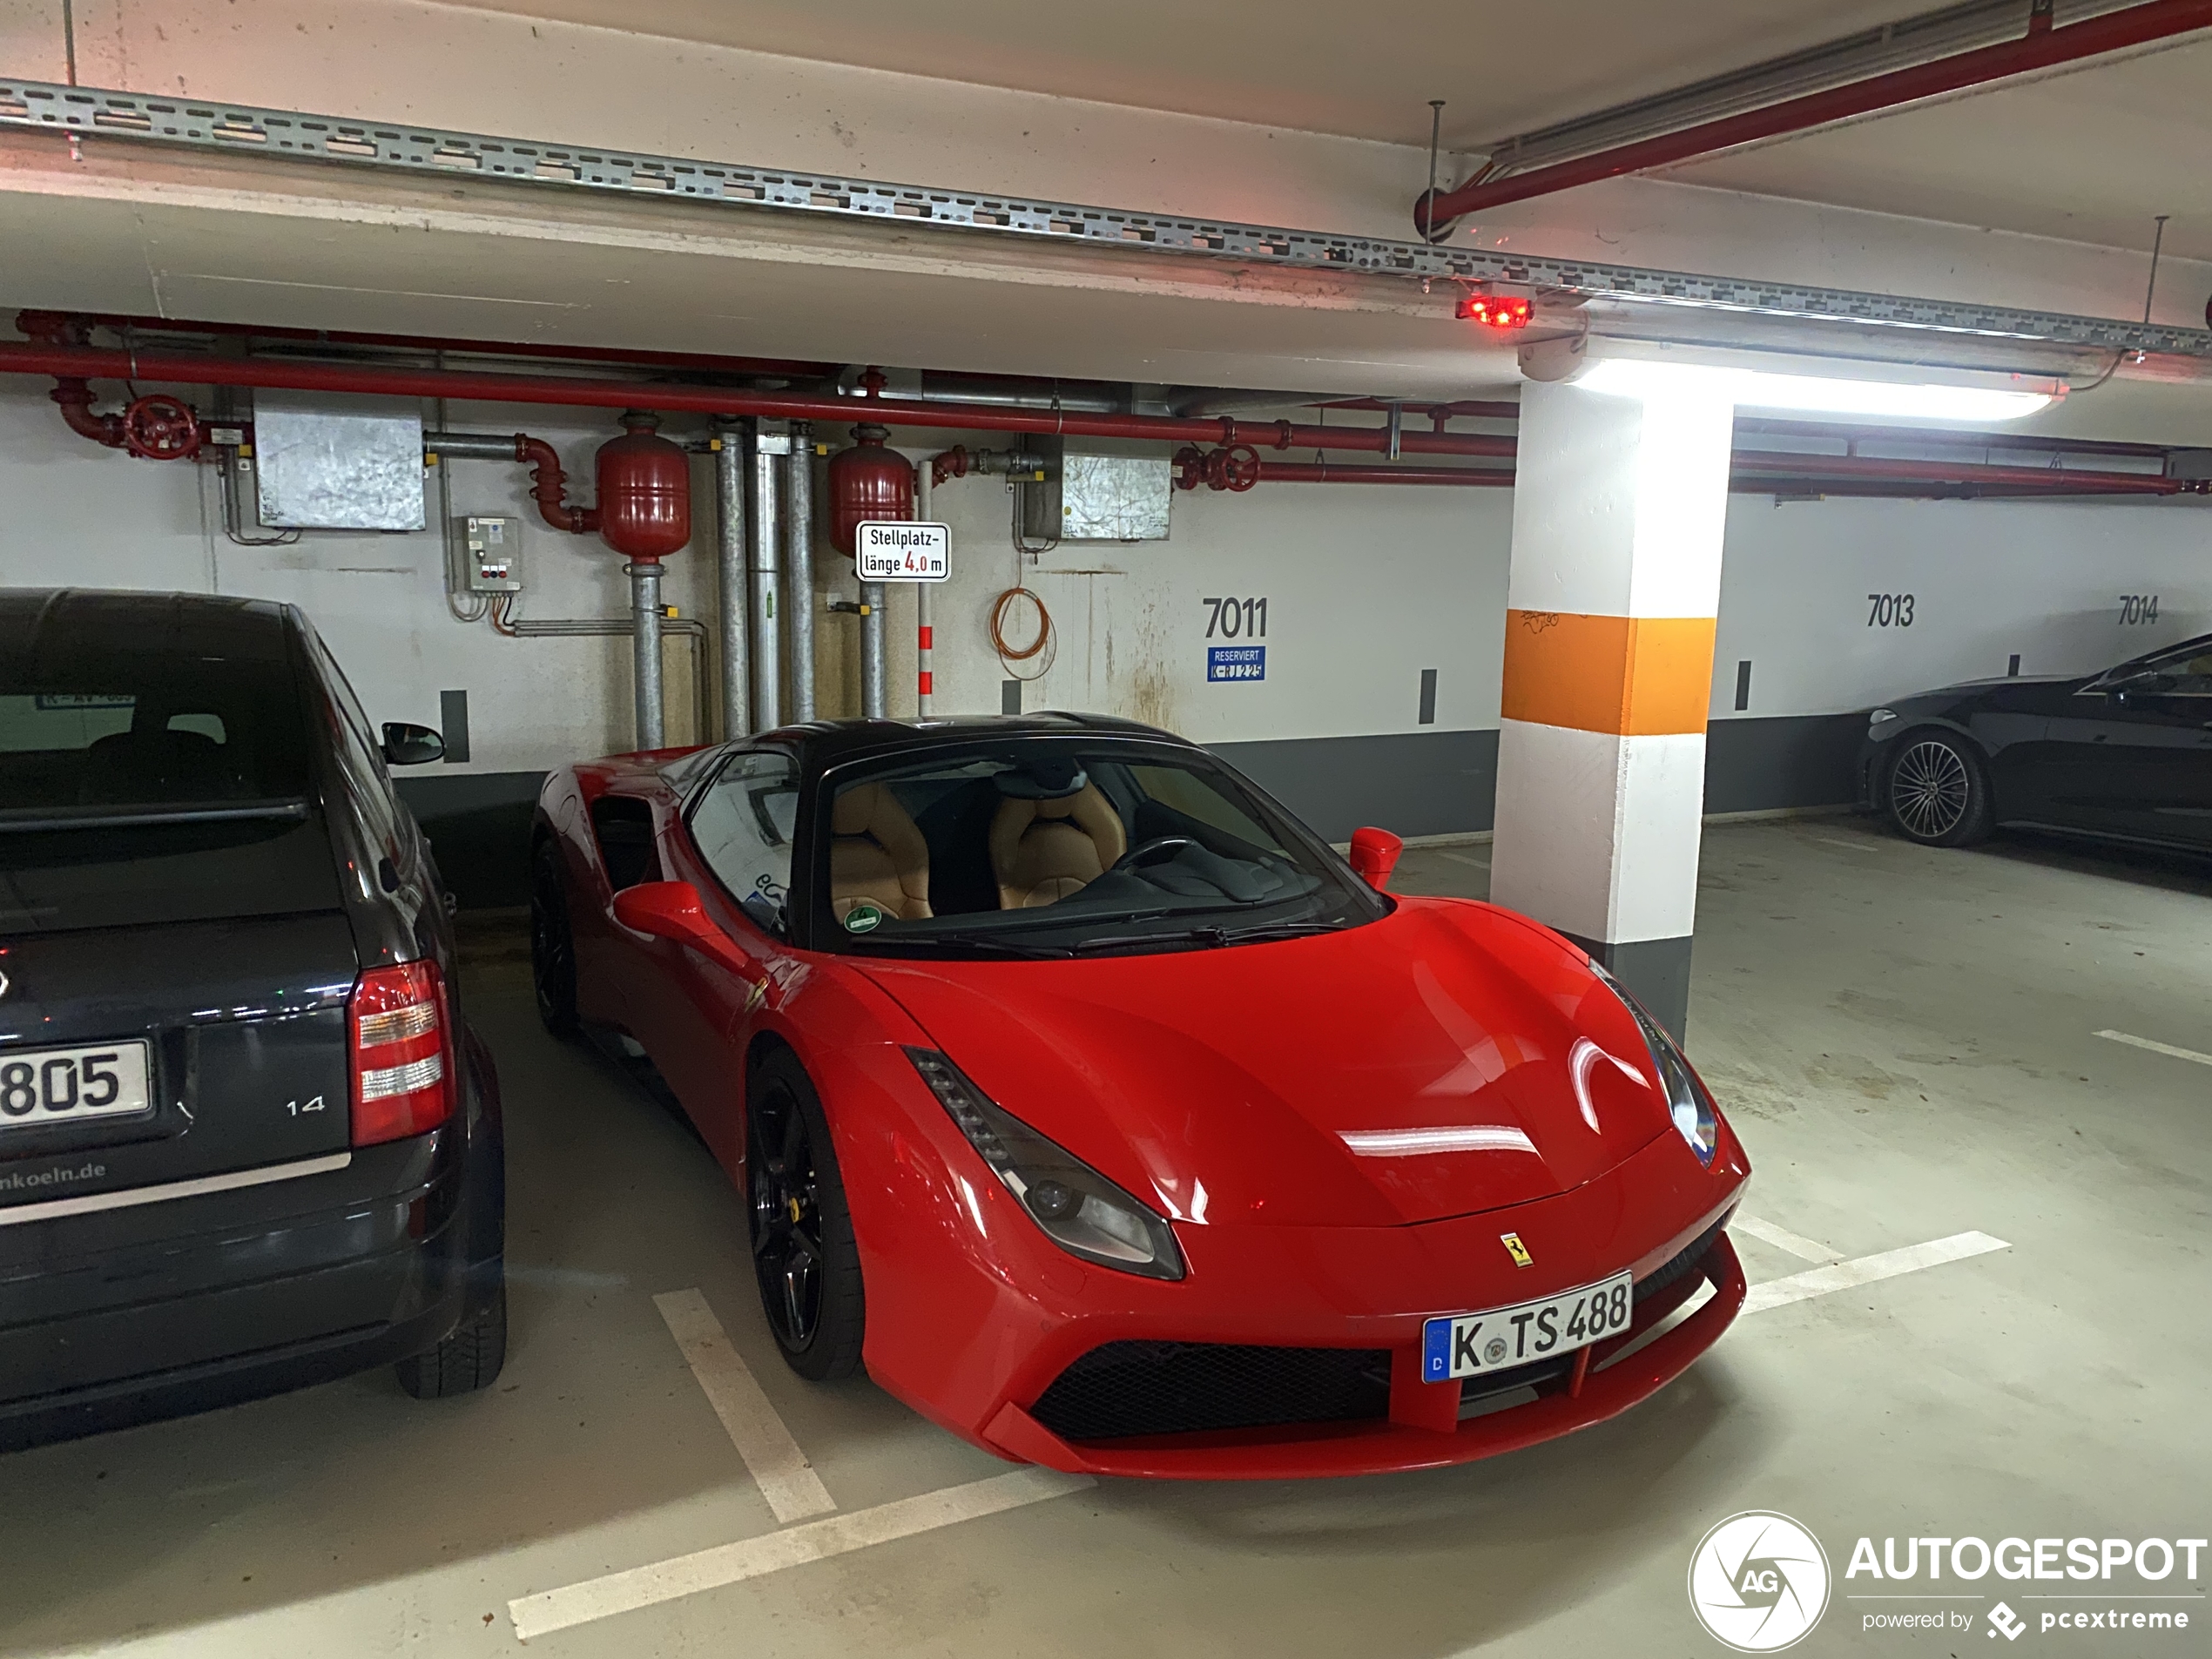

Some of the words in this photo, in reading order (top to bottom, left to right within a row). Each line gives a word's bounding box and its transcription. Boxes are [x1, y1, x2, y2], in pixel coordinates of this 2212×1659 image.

[870, 529, 940, 550] Stellplatz-
[865, 555, 900, 575] länge
[904, 550, 927, 573] 4,0
[931, 560, 942, 571] m
[1203, 597, 1267, 638] 7011
[1867, 593, 1915, 627] 7013
[2119, 595, 2158, 625] 7014
[1214, 650, 1259, 662] RESERVIERT
[0, 1052, 119, 1116] 805
[287, 1095, 326, 1116] 14
[1454, 1321, 1483, 1371] K
[1510, 1306, 1559, 1359] TS
[1567, 1284, 1627, 1341] 488
[1433, 1357, 1443, 1372] D
